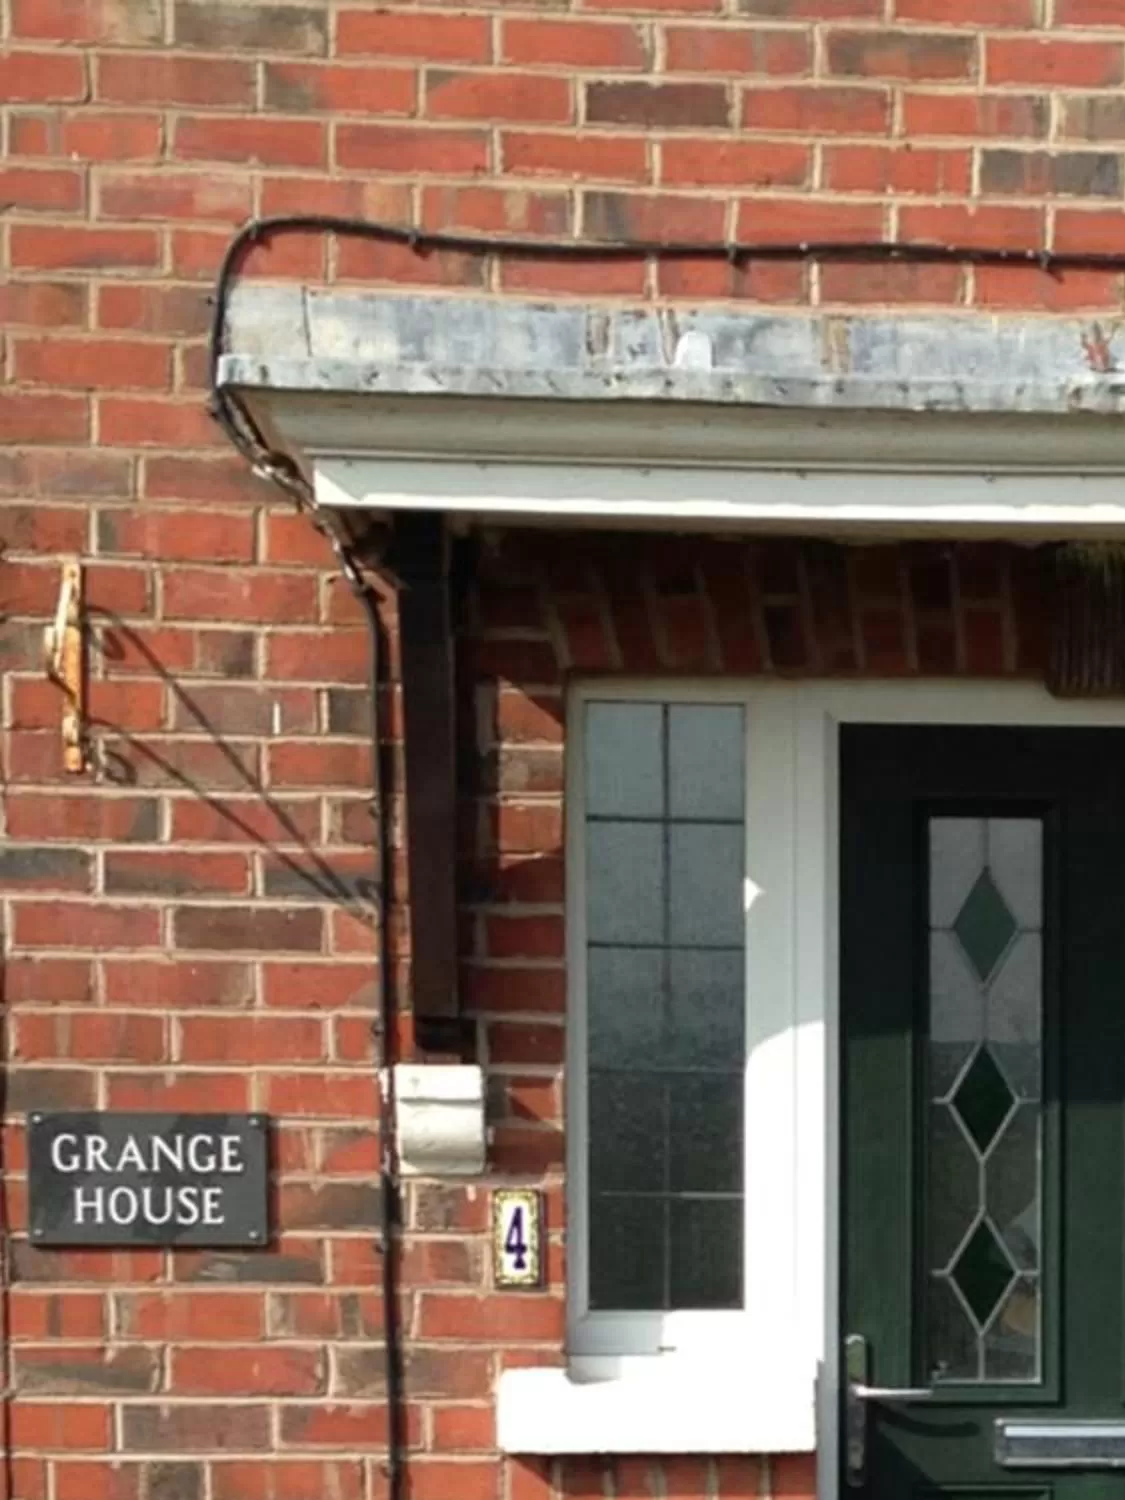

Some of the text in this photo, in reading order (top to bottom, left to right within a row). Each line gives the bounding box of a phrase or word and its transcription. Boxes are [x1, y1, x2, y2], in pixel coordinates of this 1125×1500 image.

[51, 1133, 244, 1173] GRANGE
[74, 1186, 225, 1225] HOUSE
[505, 1206, 527, 1270] 4
